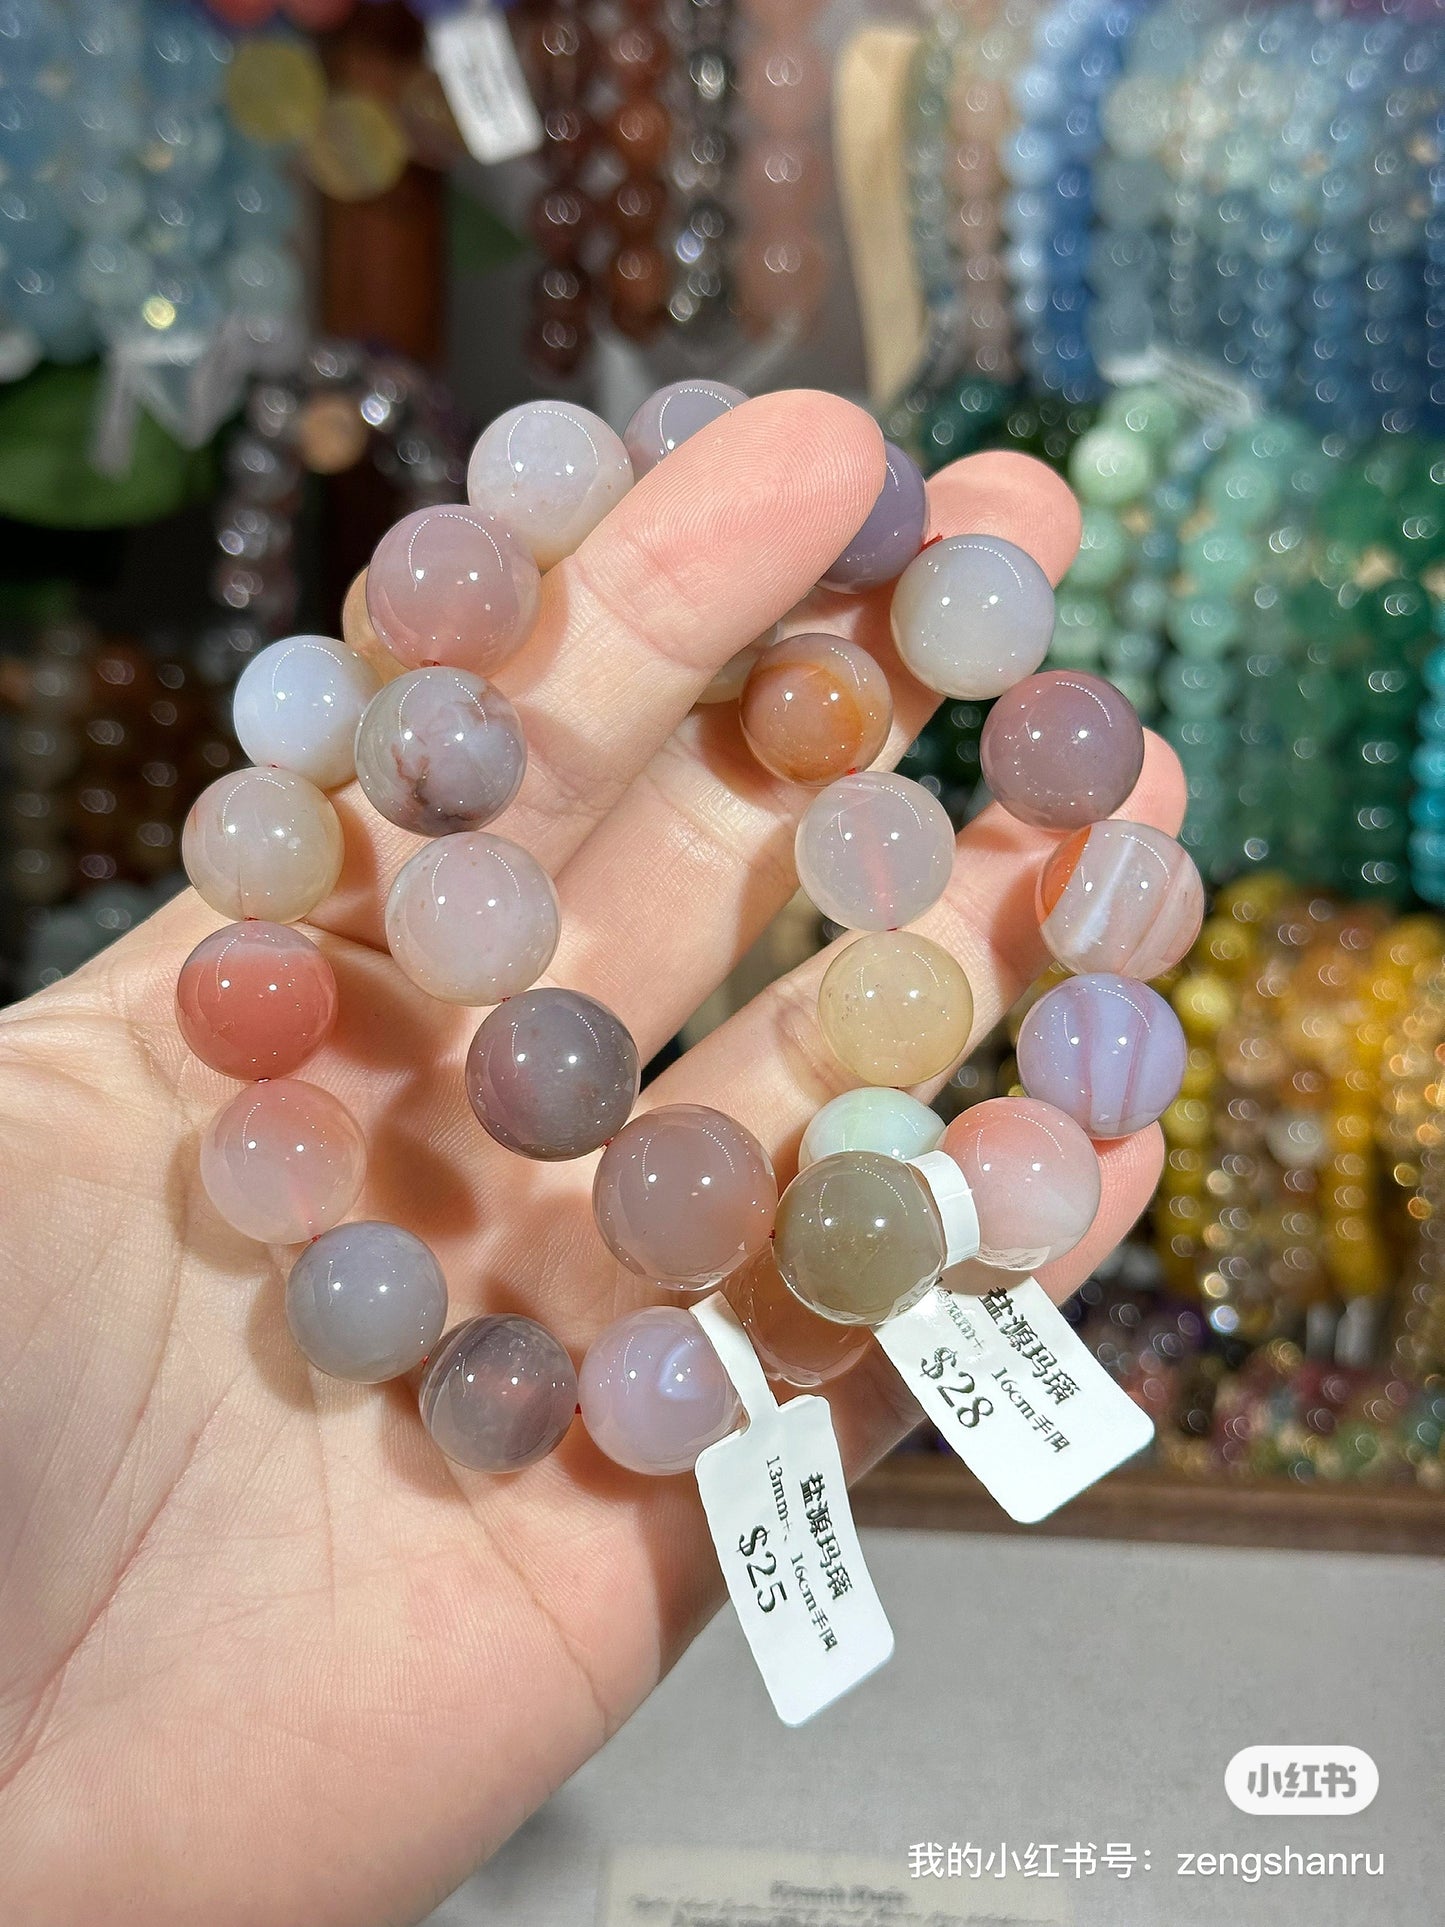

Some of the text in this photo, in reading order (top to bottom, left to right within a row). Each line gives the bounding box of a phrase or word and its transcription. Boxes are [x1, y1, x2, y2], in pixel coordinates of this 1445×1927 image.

[919, 1346, 994, 1428] $28
[977, 1286, 1081, 1405] 盐源玛瑙
[736, 1525, 788, 1613] $25
[800, 1471, 853, 1600] 盐源玛瑙
